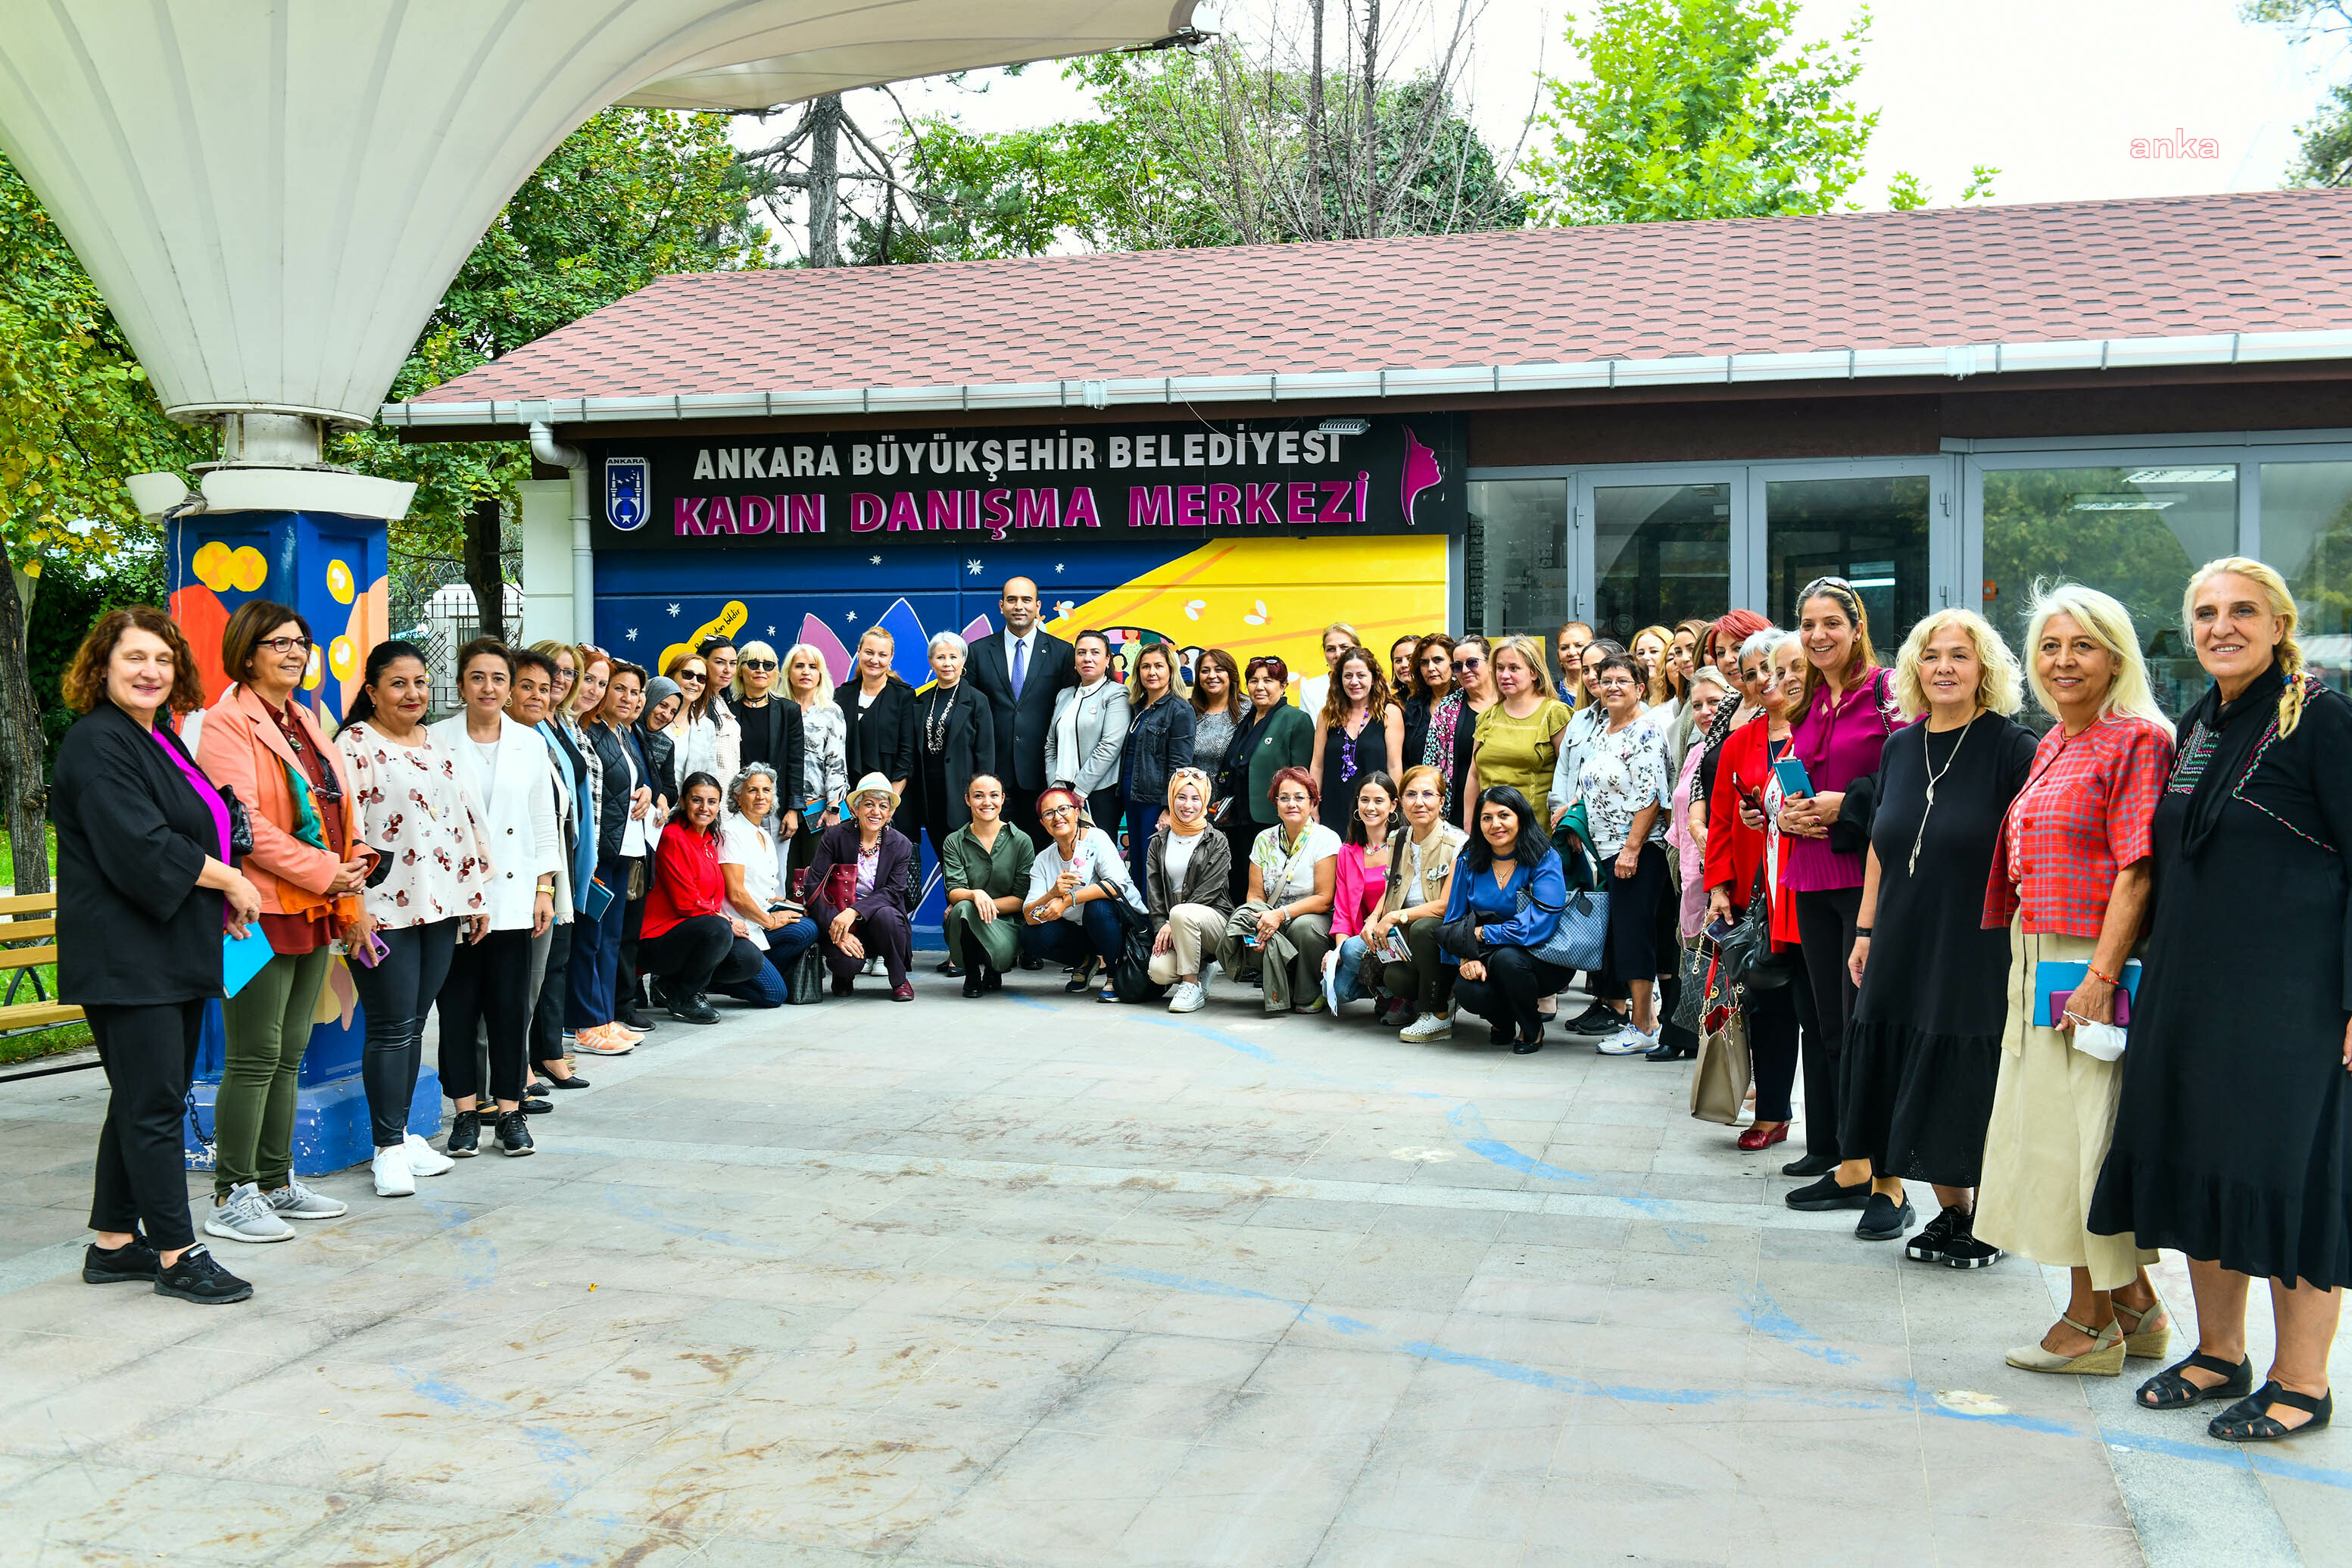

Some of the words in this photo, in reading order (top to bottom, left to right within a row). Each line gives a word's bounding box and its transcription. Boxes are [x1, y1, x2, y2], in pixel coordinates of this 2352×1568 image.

[693, 444, 841, 480] ANKARA
[852, 429, 1096, 482] BÜYÜKŞEHİR
[674, 494, 825, 536] KADIN
[850, 487, 1101, 541] DANIŞMA
[1128, 470, 1370, 527] MERKEZİ
